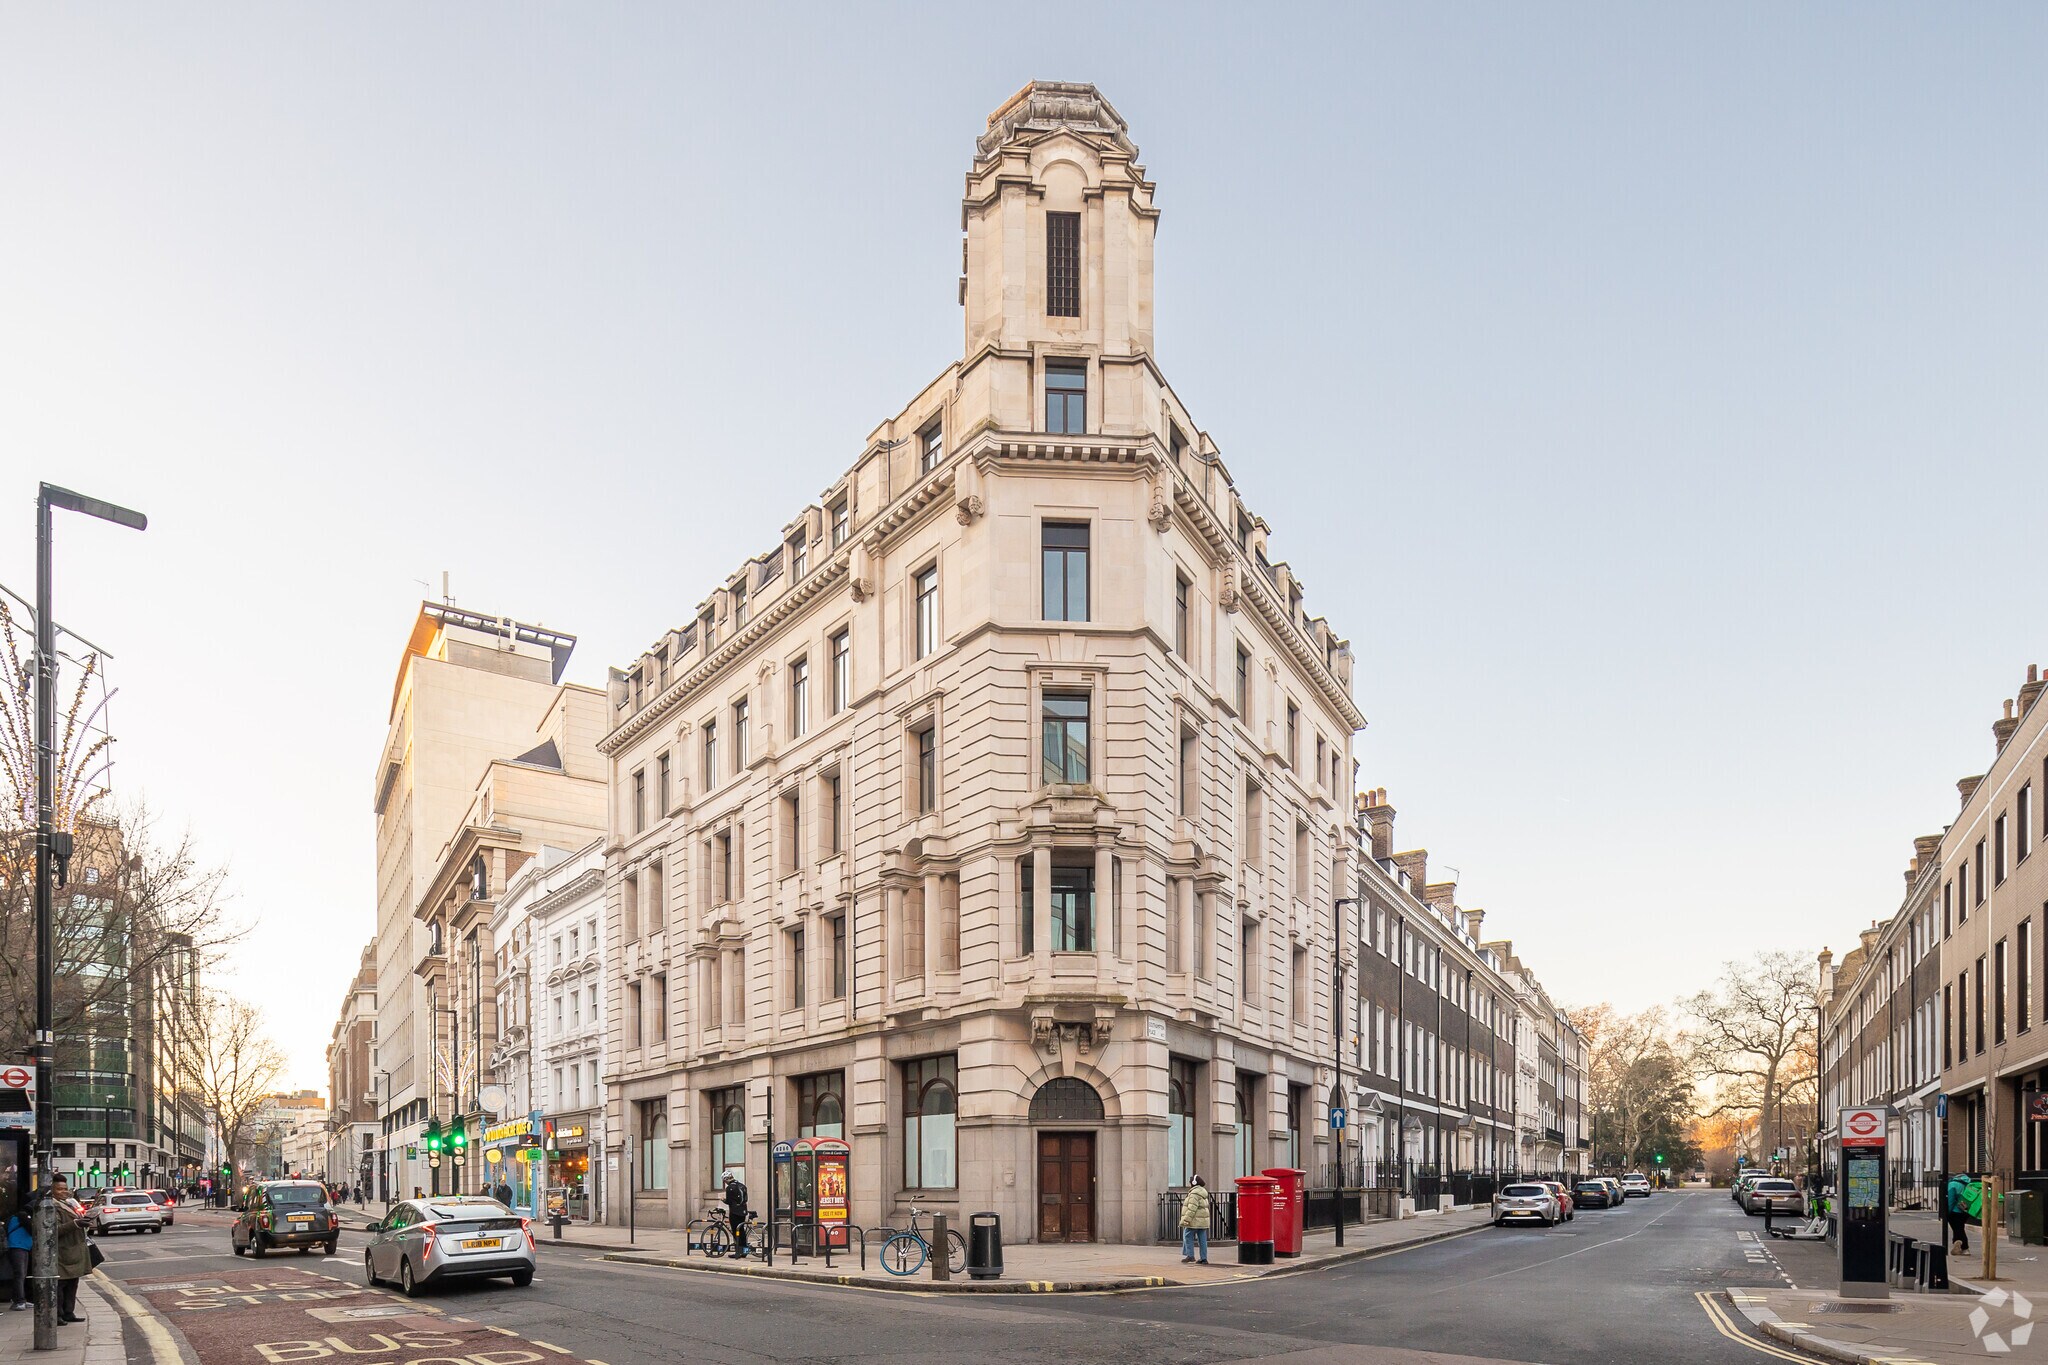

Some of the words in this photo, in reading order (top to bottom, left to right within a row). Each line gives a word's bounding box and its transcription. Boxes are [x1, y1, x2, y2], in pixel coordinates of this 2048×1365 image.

[174, 1289, 361, 1310] STOP
[177, 1281, 311, 1297] BUS
[253, 1330, 464, 1364] BUS
